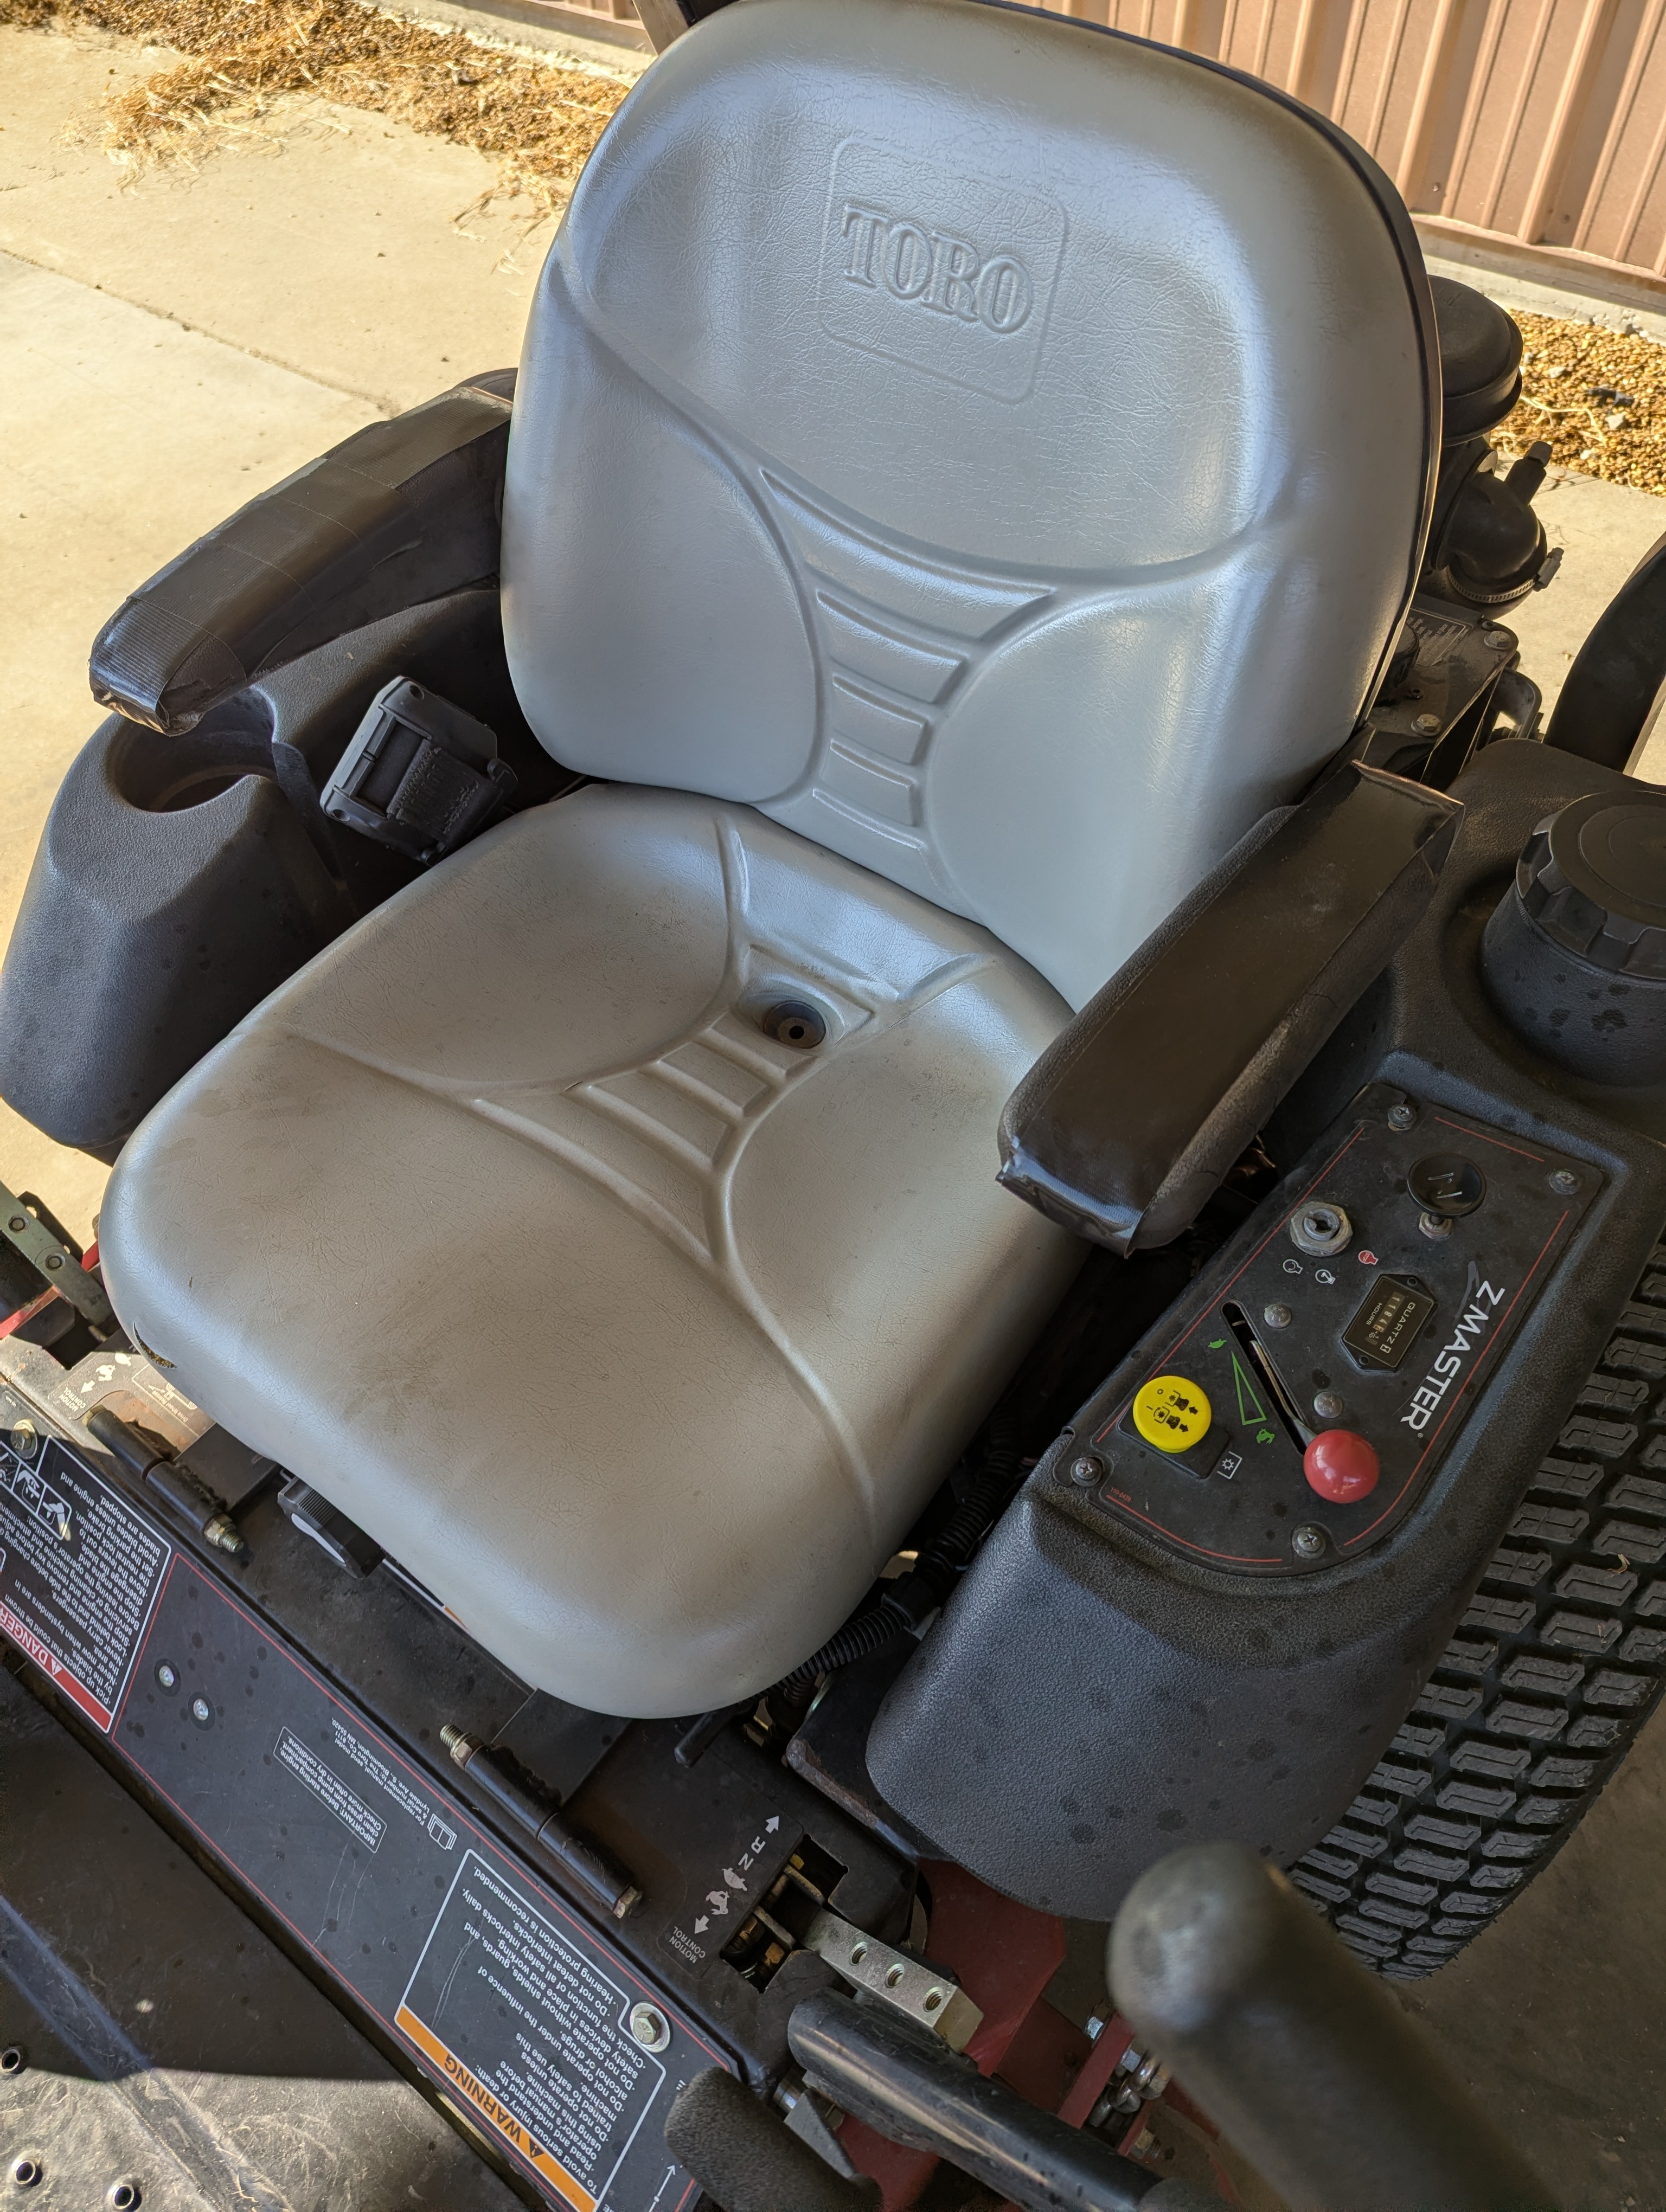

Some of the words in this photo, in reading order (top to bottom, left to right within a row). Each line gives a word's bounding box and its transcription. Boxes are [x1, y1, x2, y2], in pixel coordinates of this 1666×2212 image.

[841, 203, 1033, 334] TORO
[1476, 1281, 1505, 1305] Z
[1366, 1302, 1382, 1326] HOURS
[1386, 1302, 1416, 1344] QUARTZ
[1400, 1304, 1489, 1430] MASTER
[59, 1393, 79, 1412] MOTION
[64, 1387, 86, 1409] CONTROL
[60, 1471, 73, 1487] and
[73, 1483, 94, 1507] engine
[75, 1510, 102, 1540] position.
[94, 1503, 116, 1527] unless
[15, 1529, 35, 1554] before
[26, 1515, 54, 1545] position:
[30, 1533, 44, 1548] and
[79, 1527, 86, 1540] to
[86, 1534, 98, 1549] out
[116, 1523, 138, 1549] blades
[4, 1530, 30, 1560] changing
[34, 1547, 47, 1565] key
[101, 1536, 116, 1555] lock
[137, 1543, 158, 1567] Avoid
[29, 1557, 49, 1580] before
[43, 1545, 69, 1574] machine
[53, 1541, 84, 1574] operator's
[97, 1545, 118, 1570] levers
[114, 1549, 139, 1576] neutral
[46, 1559, 69, 1586] remove
[48, 1575, 62, 1591] side
[69, 1568, 96, 1599] cleaning
[84, 1571, 95, 1587] the
[117, 1564, 129, 1580] the
[138, 1571, 150, 1587] the
[14, 1579, 22, 1591] in
[21, 1585, 32, 1599] are
[61, 1587, 72, 1603] the
[68, 1581, 82, 1598] and
[94, 1580, 118, 1610] leaving
[128, 1575, 147, 1598] Move
[4, 1593, 25, 1619] thrown
[71, 1597, 79, 1610] to
[77, 1604, 91, 1619] and
[81, 1594, 103, 1619] engine
[95, 1596, 104, 1607] or
[25, 1615, 34, 1628] be
[31, 1596, 65, 1635] bystanders
[102, 1615, 114, 1631] the
[103, 1602, 133, 1636] servicing
[118, 1604, 140, 1631] Before
[0, 1606, 48, 1666] DANGER
[33, 1622, 51, 1643] could
[64, 1629, 81, 1650] when
[88, 1615, 111, 1642] behind
[113, 1626, 130, 1647] Stop
[50, 1639, 63, 1657] that
[80, 1646, 98, 1666] mow
[110, 1635, 126, 1657] Look
[63, 1652, 86, 1679] objects
[96, 1662, 116, 1686] Never
[86, 1676, 95, 1689] up
[94, 1684, 110, 1705] Pick
[334, 1729, 347, 1744] 8111
[334, 1737, 351, 1754] model
[346, 1732, 356, 1745] MN
[349, 1752, 363, 1767] send
[357, 1750, 369, 1765] Toro
[369, 1761, 379, 1775] The
[298, 1766, 321, 1791] starting
[316, 1764, 327, 1777] dry
[326, 1773, 334, 1785] in
[317, 1774, 335, 1794] pump
[332, 1780, 348, 1797] often
[386, 1779, 407, 1800] number
[319, 1788, 339, 1811] Before
[333, 1790, 347, 1808] from
[347, 1794, 363, 1812] more
[383, 1783, 415, 1816] replacement
[406, 1797, 422, 1814] serial
[408, 1791, 430, 1814] Lyndale
[347, 1804, 364, 1822] grass
[362, 1808, 381, 1831] Check
[414, 1814, 425, 1826] For
[362, 1819, 379, 1837] clean
[751, 1836, 766, 1854] R
[738, 1853, 754, 1870] N
[462, 1888, 482, 1911] daily.
[473, 1865, 530, 1923] recommended.
[463, 1921, 480, 1939] and
[482, 1908, 521, 1950] interlocks
[529, 1920, 539, 1933] is
[481, 1935, 511, 1968] guards,
[538, 1928, 581, 1971] protection
[669, 1936, 698, 1963] MOTION
[673, 1926, 706, 1958] CONTROL
[497, 1938, 530, 1975] working.
[520, 1945, 546, 1972] safety
[477, 1965, 488, 1977] of
[511, 1964, 542, 1999] shields,
[529, 1971, 547, 1990] and
[544, 1970, 557, 1983] all
[487, 1975, 524, 2015] influence
[555, 1980, 566, 1992] of
[580, 1966, 614, 2004] Hearing
[546, 1988, 571, 2012] place
[566, 1990, 601, 2028] function
[523, 2010, 537, 2028] the
[541, 1996, 572, 2030] without
[569, 2009, 579, 2023] in
[536, 2024, 562, 2051] under
[572, 2027, 604, 2060] operate
[578, 2019, 611, 2053] devices
[601, 2024, 616, 2042] the
[616, 2037, 644, 2068] Check
[499, 2060, 526, 2091] before
[562, 2048, 594, 2081] operate
[604, 2057, 620, 2075] not
[611, 2050, 638, 2079] safety
[475, 2064, 499, 2092] death:
[495, 2069, 509, 2086] the
[593, 2079, 610, 2097] not
[619, 2074, 633, 2091] Do
[444, 2053, 521, 2143] WARNING
[498, 2090, 509, 2101] or
[508, 2082, 554, 2131] understand
[524, 2086, 556, 2119] manual
[609, 2095, 623, 2112] Do
[509, 2099, 533, 2127] injury
[533, 2123, 563, 2156] serious
[552, 2128, 571, 2147] and
[555, 2116, 597, 2160] operator's
[562, 2154, 587, 2180] avoid
[569, 2145, 593, 2171] Read
[586, 2178, 597, 2194] To
